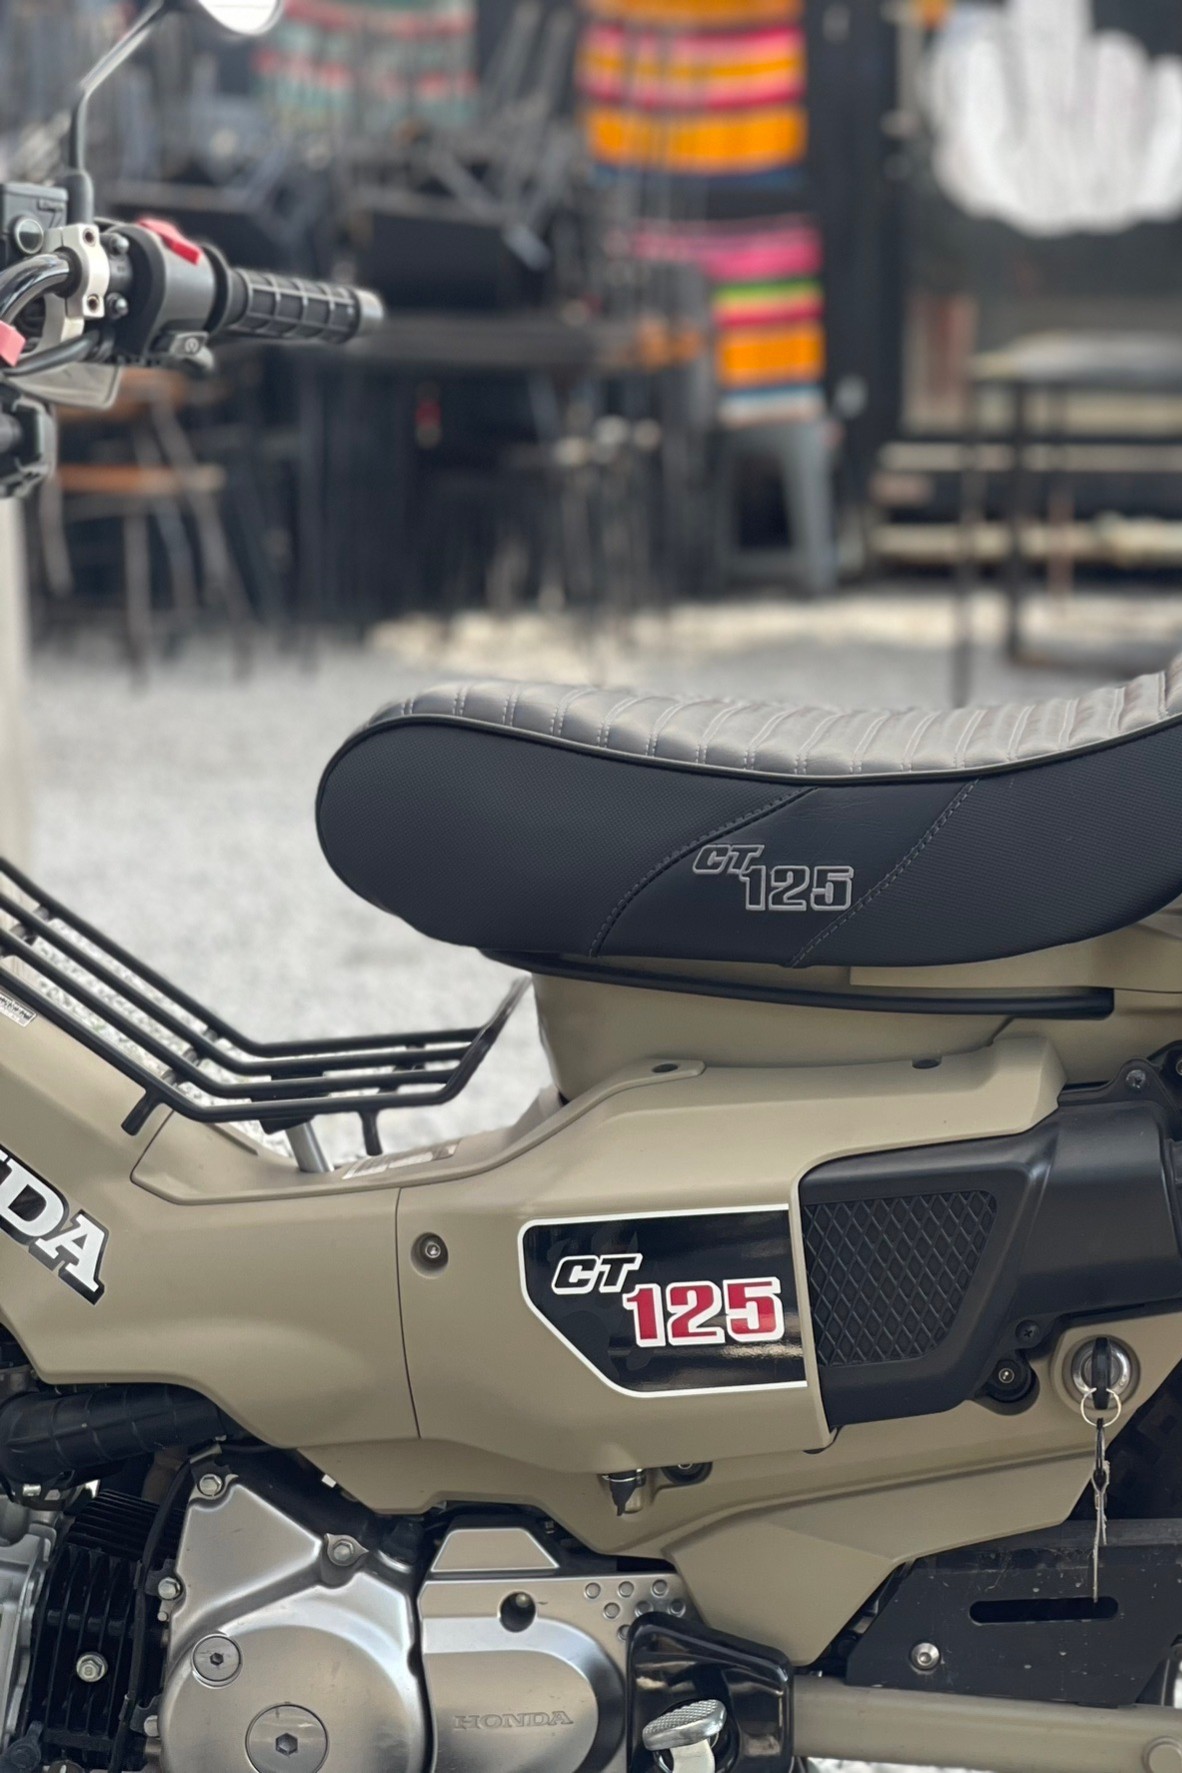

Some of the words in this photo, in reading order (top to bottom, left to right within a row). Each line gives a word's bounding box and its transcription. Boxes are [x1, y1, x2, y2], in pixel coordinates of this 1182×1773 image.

[693, 845, 765, 874] CT
[739, 865, 854, 911] 125
[0, 1145, 109, 1304] DA
[552, 1253, 643, 1295] CT
[622, 1276, 785, 1347] 125
[453, 1710, 574, 1730] HONDA
